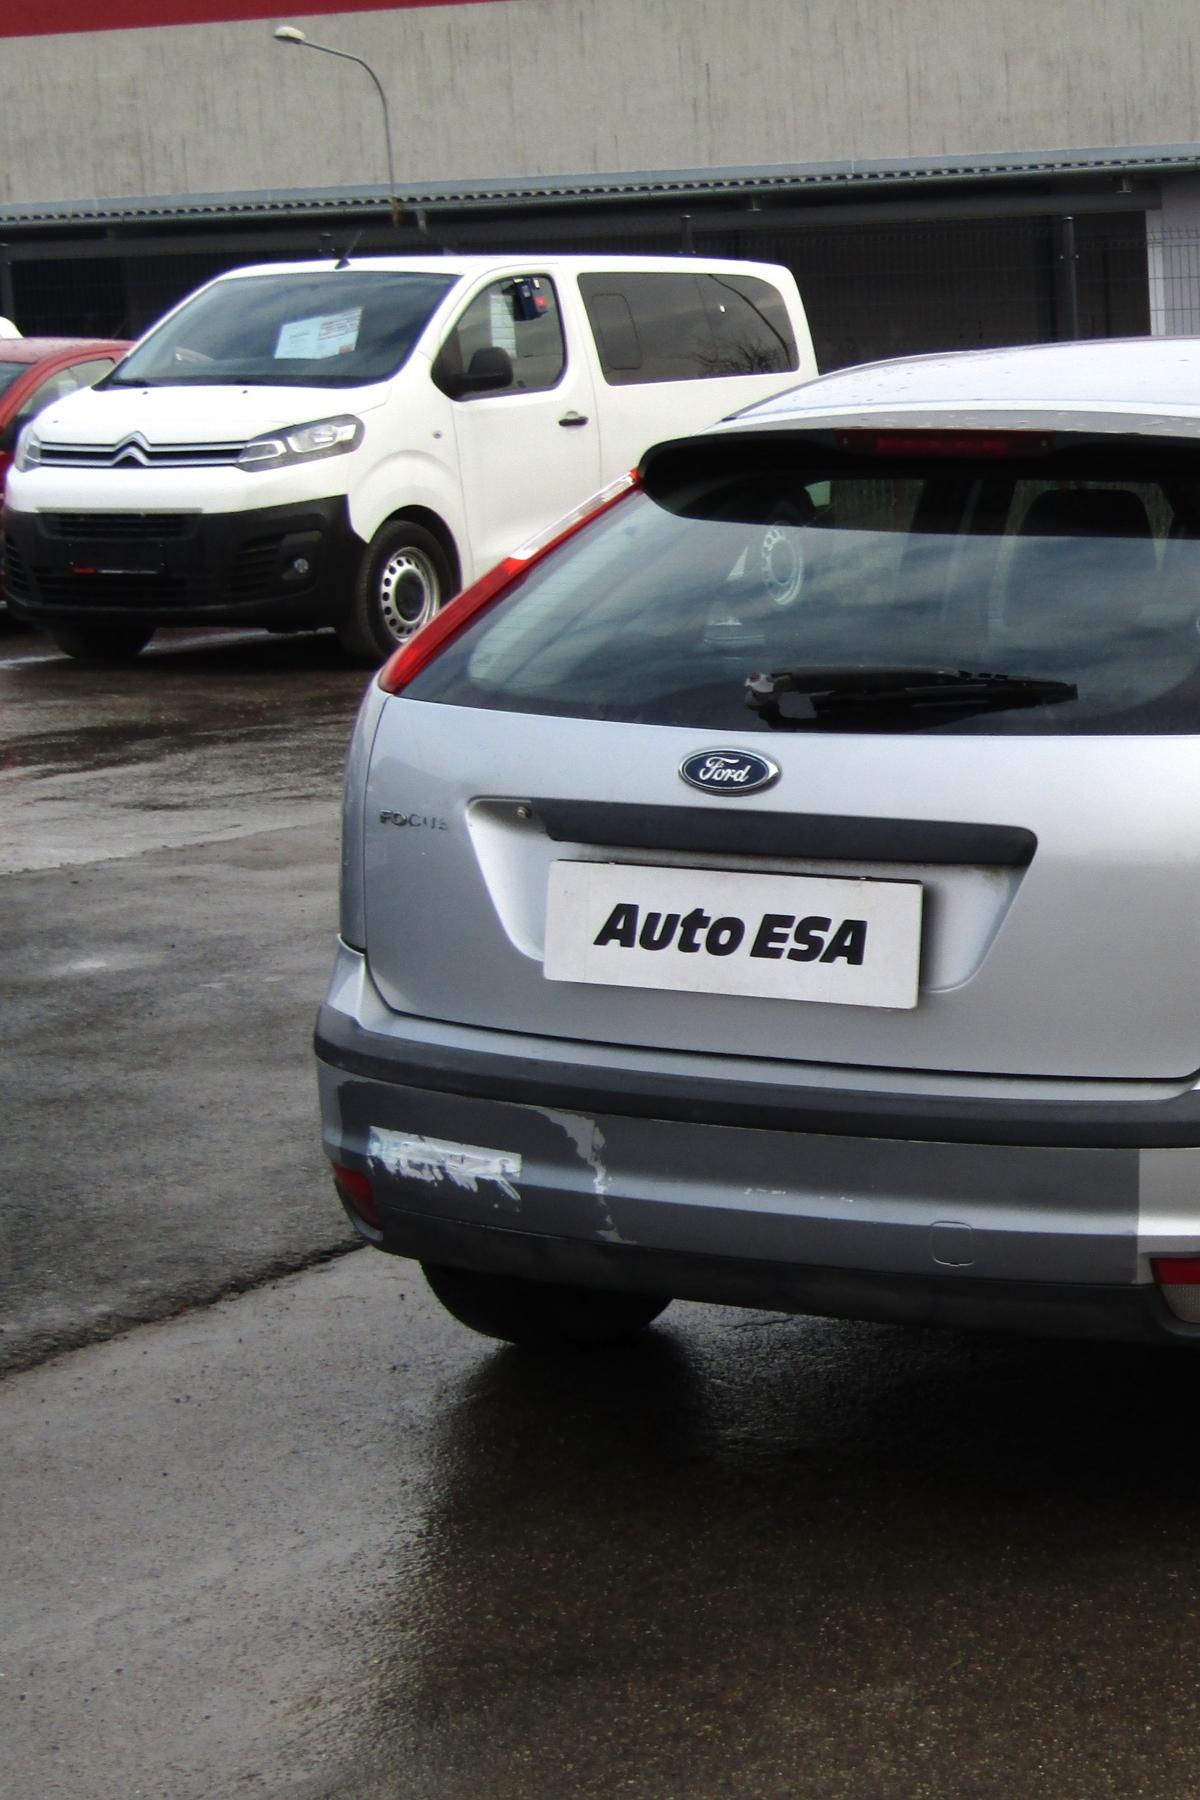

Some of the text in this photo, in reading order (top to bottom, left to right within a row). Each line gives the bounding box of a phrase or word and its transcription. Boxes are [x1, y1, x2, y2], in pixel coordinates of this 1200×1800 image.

[699, 756, 751, 782] Ford
[379, 809, 448, 831] FOCUS
[593, 903, 868, 965] Auto ESA
